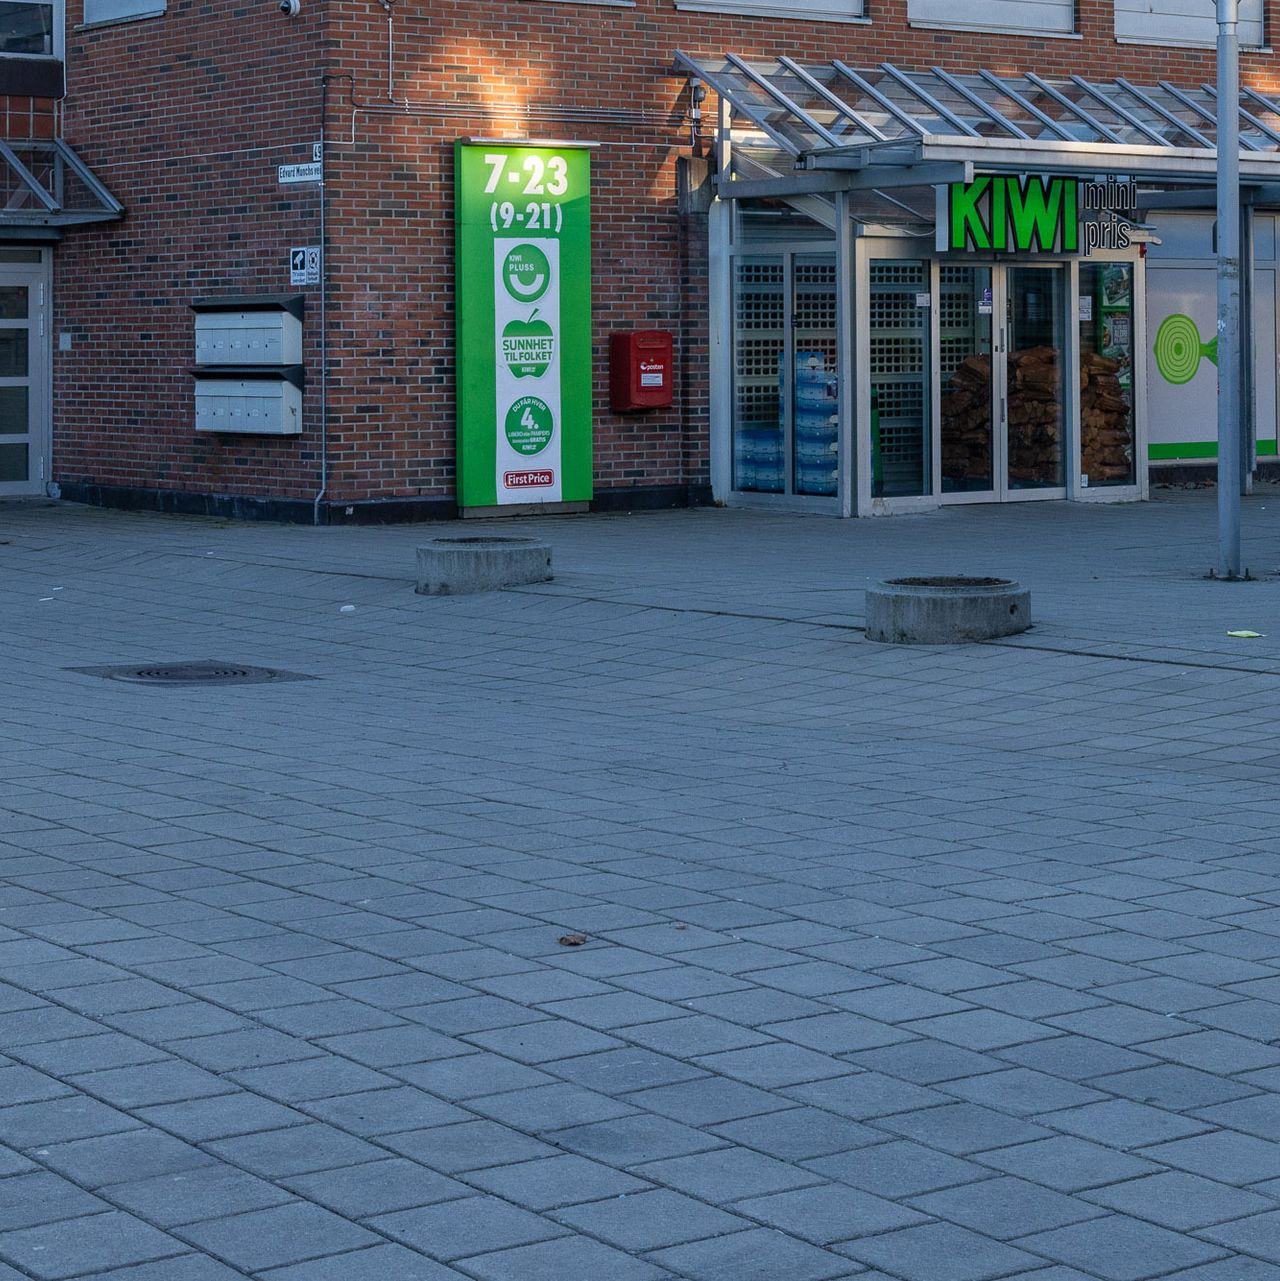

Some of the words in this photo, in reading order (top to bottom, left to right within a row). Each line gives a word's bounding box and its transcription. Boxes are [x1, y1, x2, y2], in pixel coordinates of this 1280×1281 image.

[484, 154, 568, 195] 7-23
[1084, 175, 1137, 209] mini
[490, 202, 562, 233] (9-21)
[949, 173, 1079, 253] KIWI
[1084, 213, 1131, 257] pris
[509, 263, 535, 271] PLUSS
[502, 338, 554, 350] SUNNHET
[504, 352, 517, 361] TIL
[519, 351, 552, 361] FOLKET
[521, 407, 539, 429] 4.
[507, 474, 527, 484] First
[528, 473, 550, 484] Price
